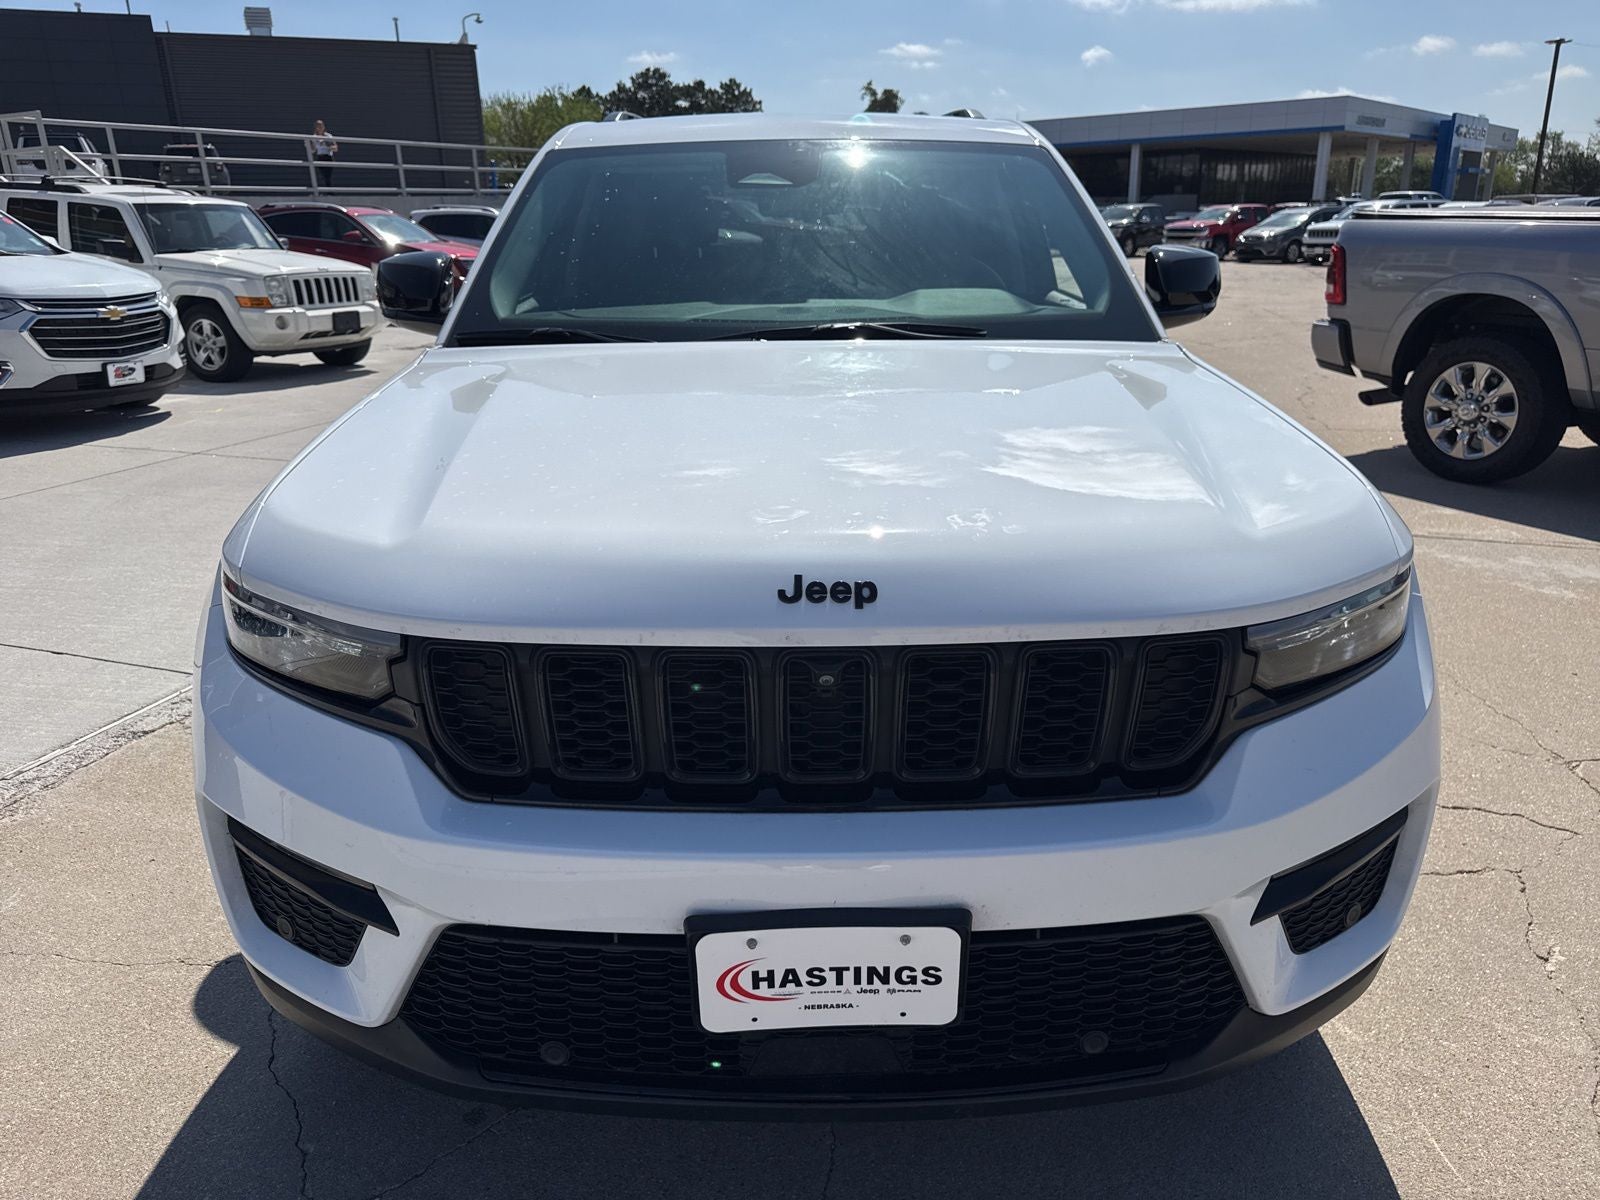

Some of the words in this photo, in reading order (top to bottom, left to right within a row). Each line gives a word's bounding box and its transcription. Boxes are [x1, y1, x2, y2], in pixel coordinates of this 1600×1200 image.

[777, 574, 878, 609] Jeep
[751, 965, 943, 990] HASTINGS
[856, 987, 880, 995] Jeep
[803, 1002, 854, 1010] NEBRASKA
